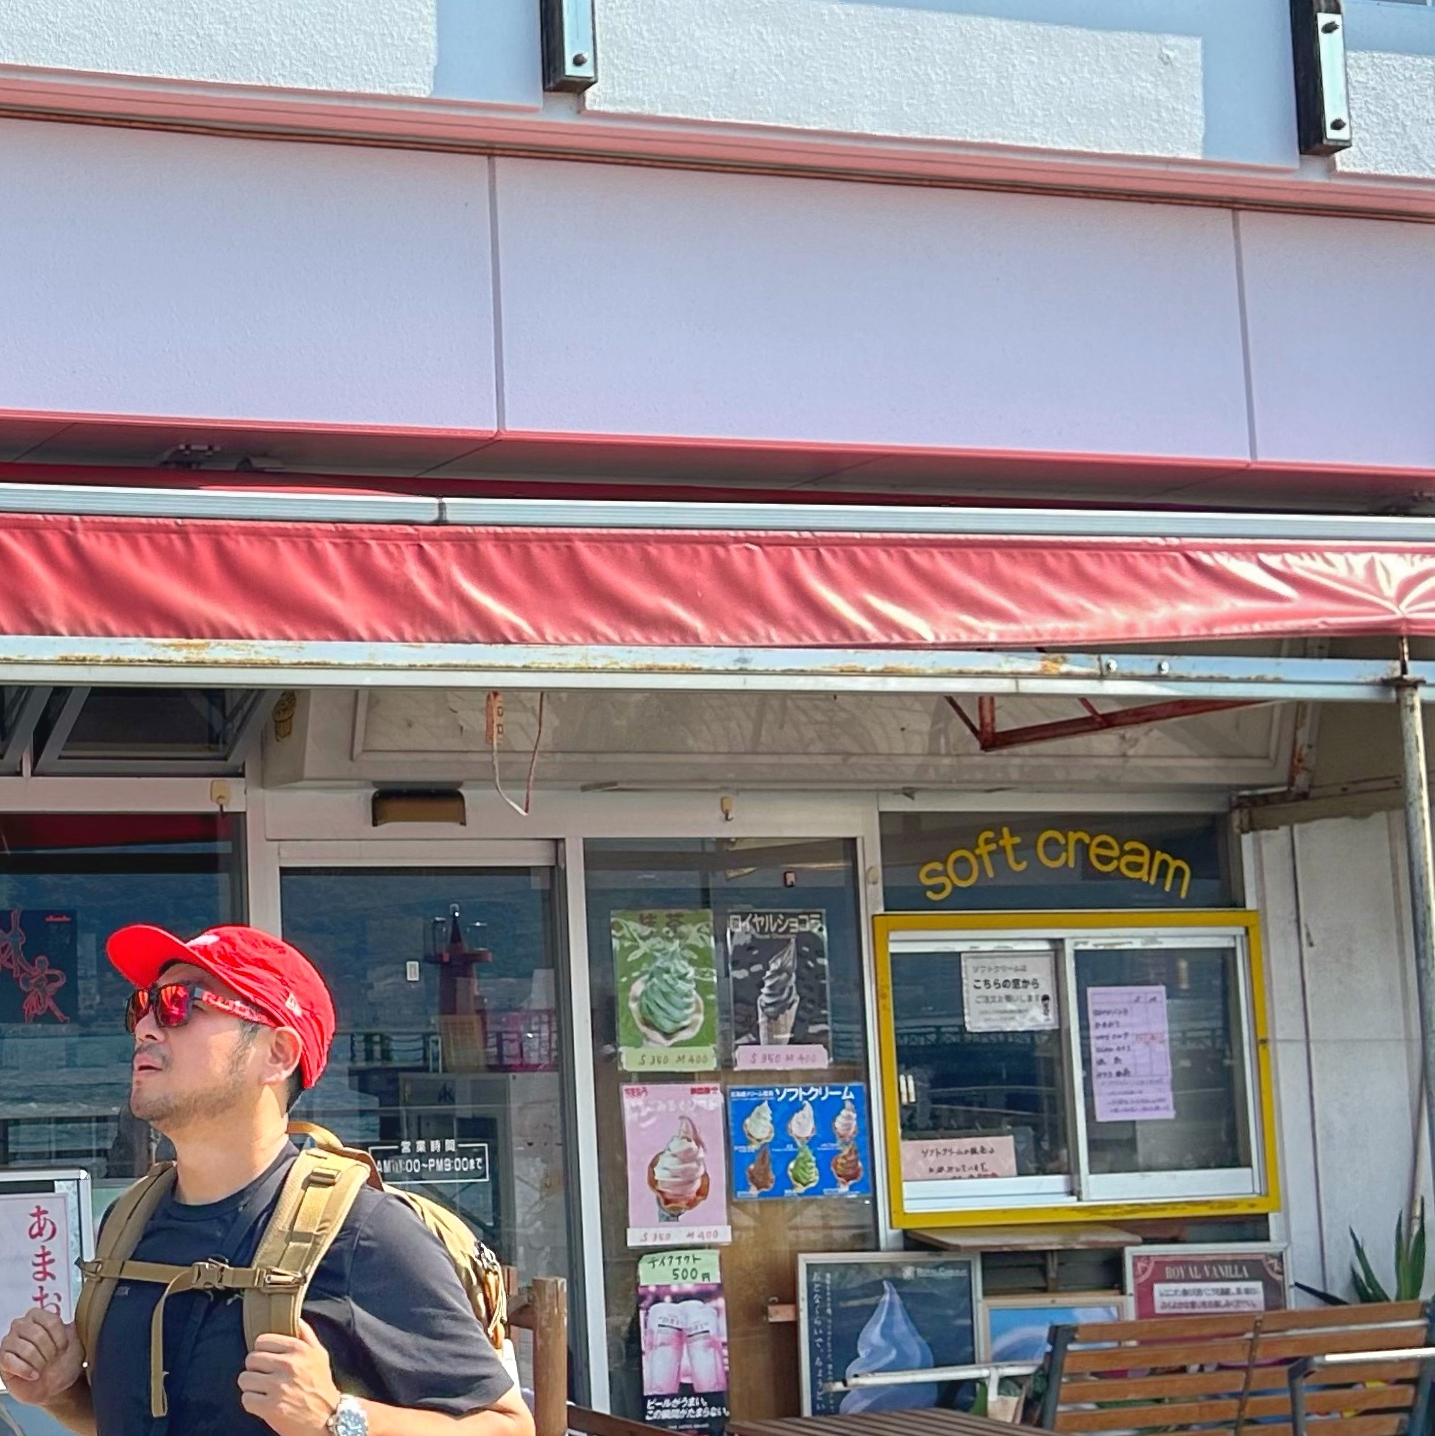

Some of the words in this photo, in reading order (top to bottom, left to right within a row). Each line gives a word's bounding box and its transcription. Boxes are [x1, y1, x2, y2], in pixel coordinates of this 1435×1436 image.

[919, 826, 1028, 900] soft
[1036, 829, 1192, 899] cream
[973, 978, 1040, 990] こちらの窓から
[775, 1086, 855, 1102] ソフトクリーム
[400, 1139, 456, 1154] 営業時間
[1166, 1265, 1201, 1279] ROYAL
[1204, 1264, 1249, 1279] VANILLA
